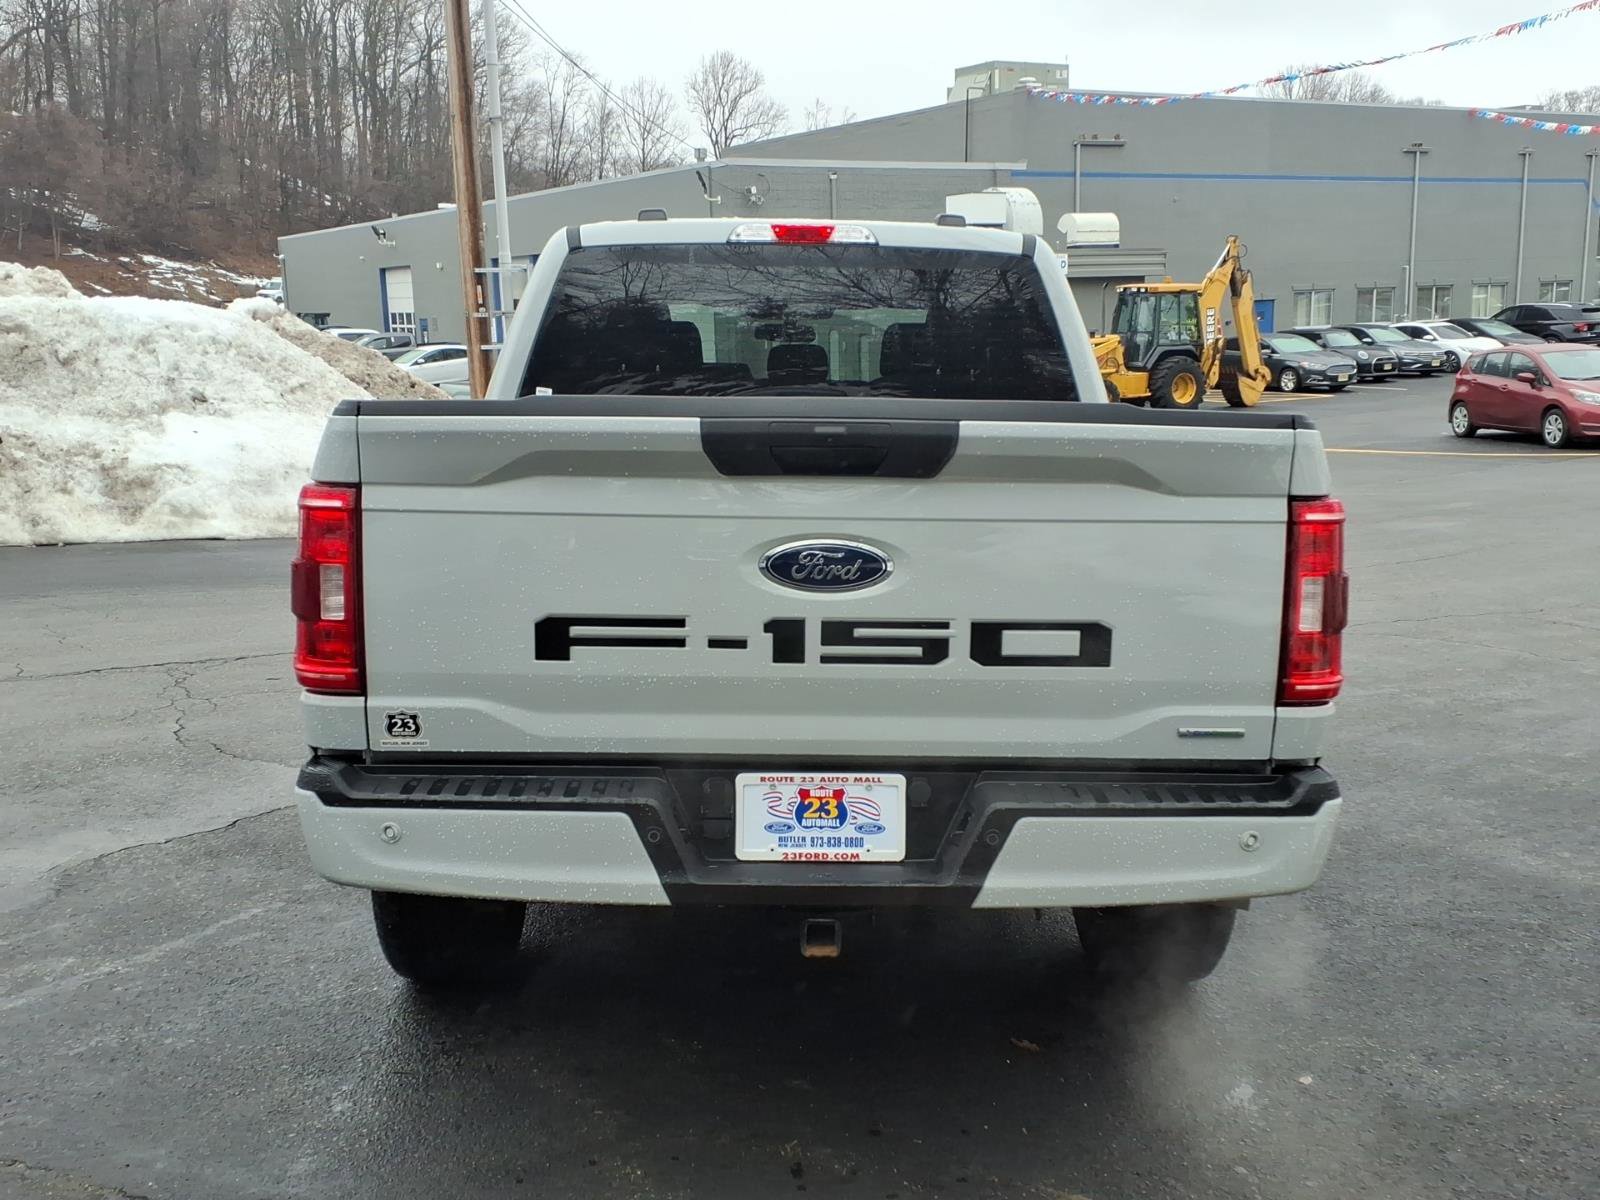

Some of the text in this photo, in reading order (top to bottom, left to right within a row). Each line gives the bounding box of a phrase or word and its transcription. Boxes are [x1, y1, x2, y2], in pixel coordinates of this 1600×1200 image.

[791, 550, 863, 580] Ford
[535, 614, 1112, 667] F-150
[391, 718, 416, 731] 23
[810, 789, 833, 797] ROUTE
[803, 798, 839, 819] 23
[801, 819, 841, 827] AUTOMALL
[810, 836, 864, 848] 973-838-0800
[782, 852, 860, 860] 23FORD.COM
